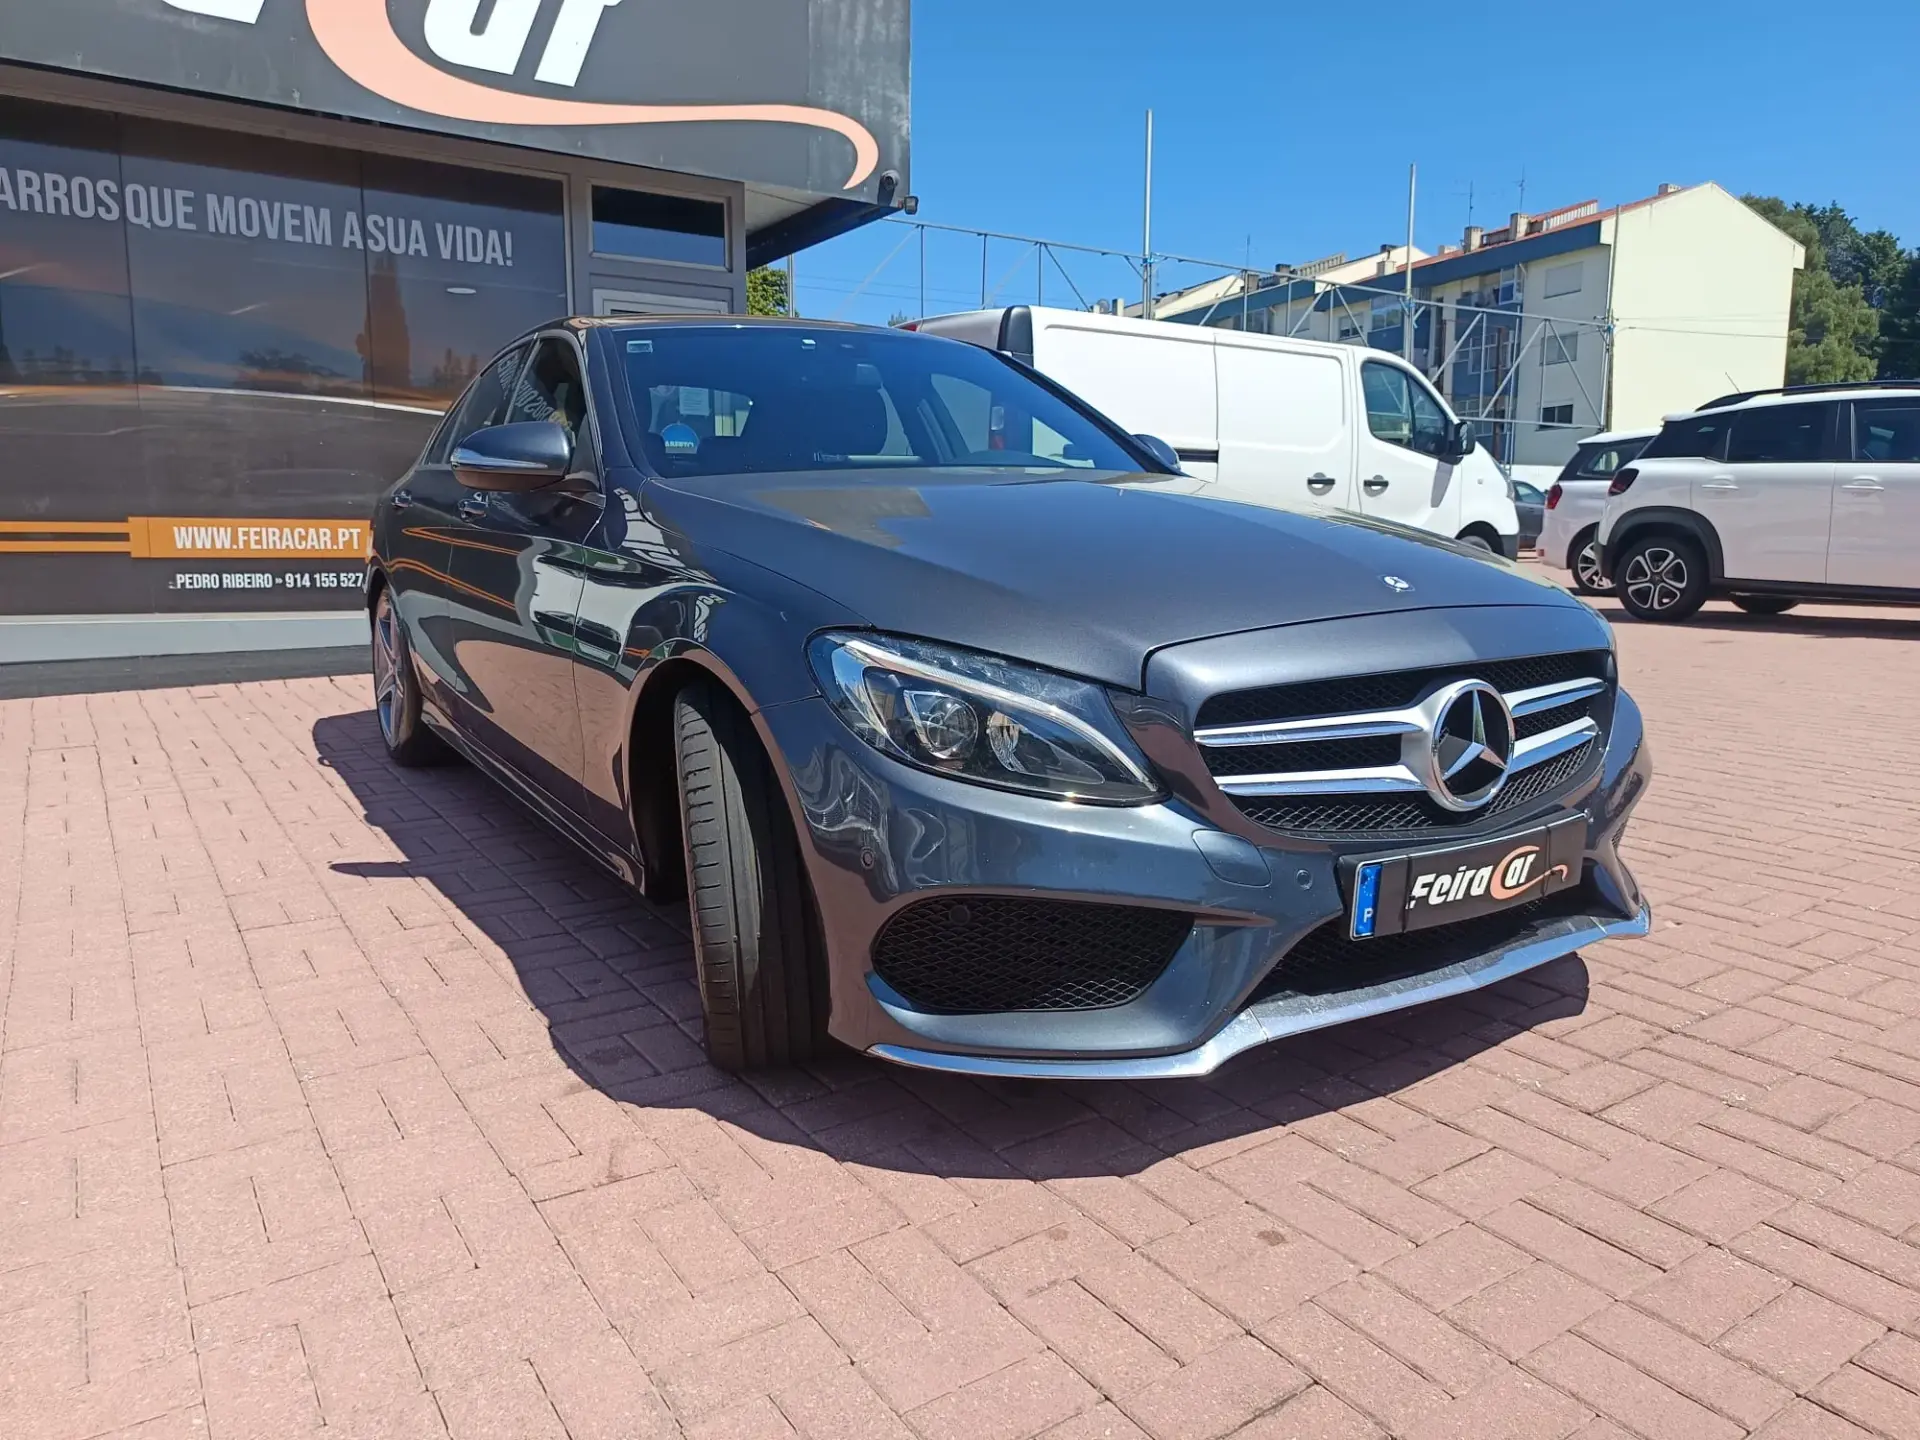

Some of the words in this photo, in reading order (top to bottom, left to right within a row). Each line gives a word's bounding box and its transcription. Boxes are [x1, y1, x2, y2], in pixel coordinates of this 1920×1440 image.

[125, 183, 197, 231] QUE
[206, 193, 333, 247] MOVEM
[342, 211, 364, 250] A
[366, 214, 429, 257] SUA
[435, 222, 514, 267] VIDA!
[173, 526, 361, 550] WWW.FEIRACAR.PT
[175, 573, 219, 589] PEDRO
[222, 573, 273, 588] RIBEIRO
[285, 573, 311, 588] 914
[313, 573, 338, 588] 155
[339, 572, 364, 588] 527
[1363, 907, 1374, 923] P
